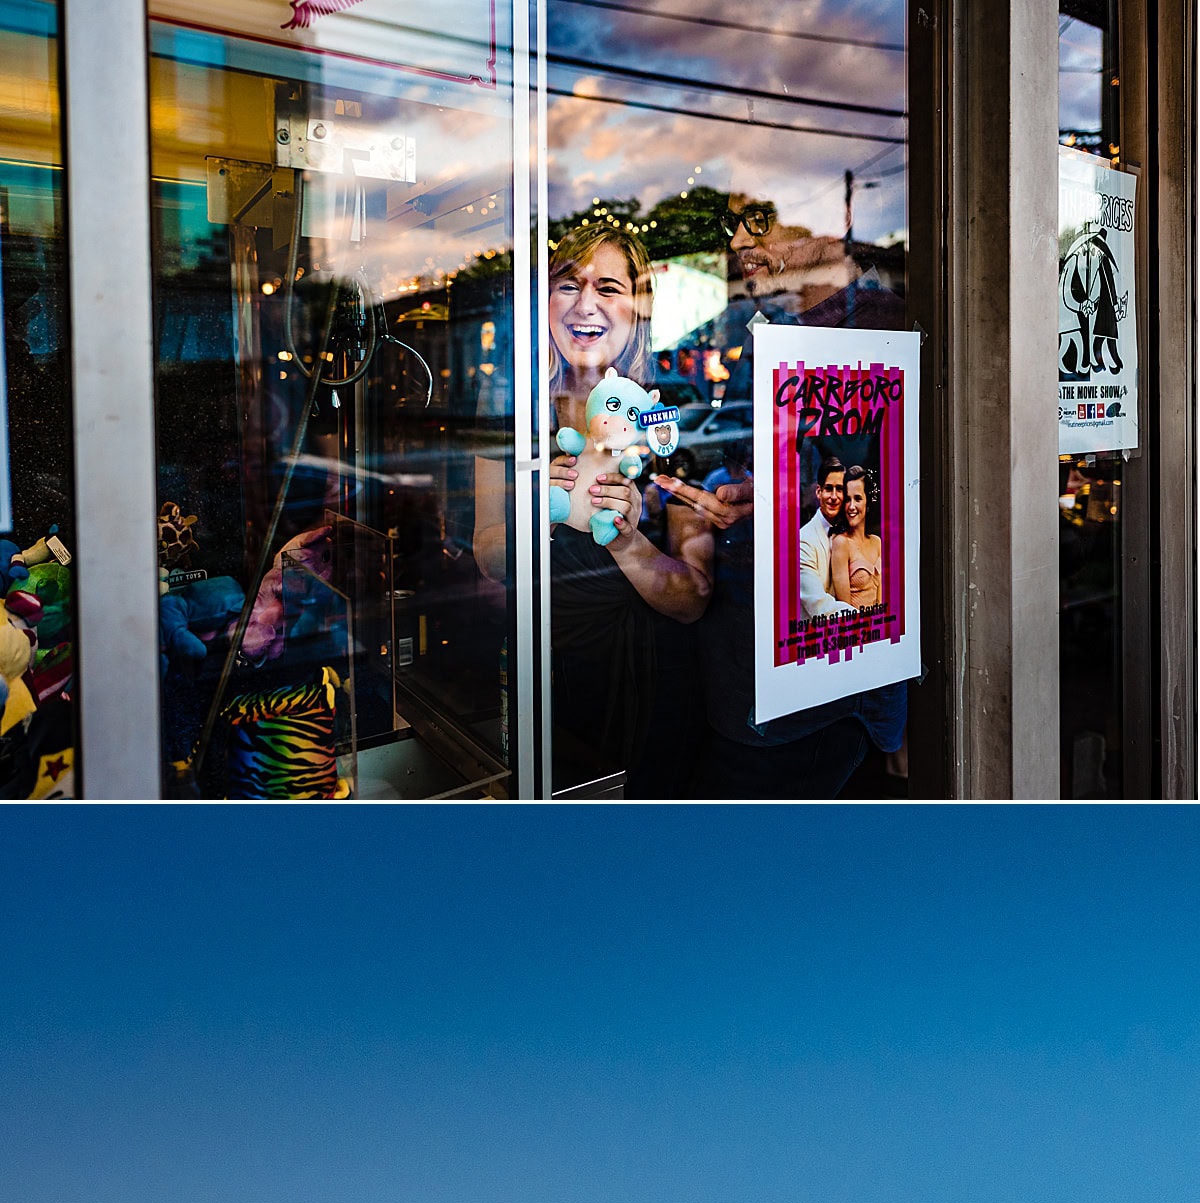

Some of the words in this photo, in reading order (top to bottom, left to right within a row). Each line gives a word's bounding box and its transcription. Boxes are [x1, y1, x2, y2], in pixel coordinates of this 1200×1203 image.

[776, 375, 903, 408] CARRBORO
[1062, 386, 1075, 400] THE
[1077, 386, 1098, 400] MOVIE
[1100, 385, 1120, 399] SHOW
[643, 410, 677, 424] PARKWAY
[796, 406, 885, 454] PROM
[657, 442, 674, 455] TOYS
[185, 572, 202, 581] TOYS
[789, 618, 810, 635] May
[812, 613, 828, 629] 4th
[829, 612, 839, 626] at
[841, 607, 857, 622] The
[859, 602, 888, 617] Baxter
[797, 641, 821, 659] from
